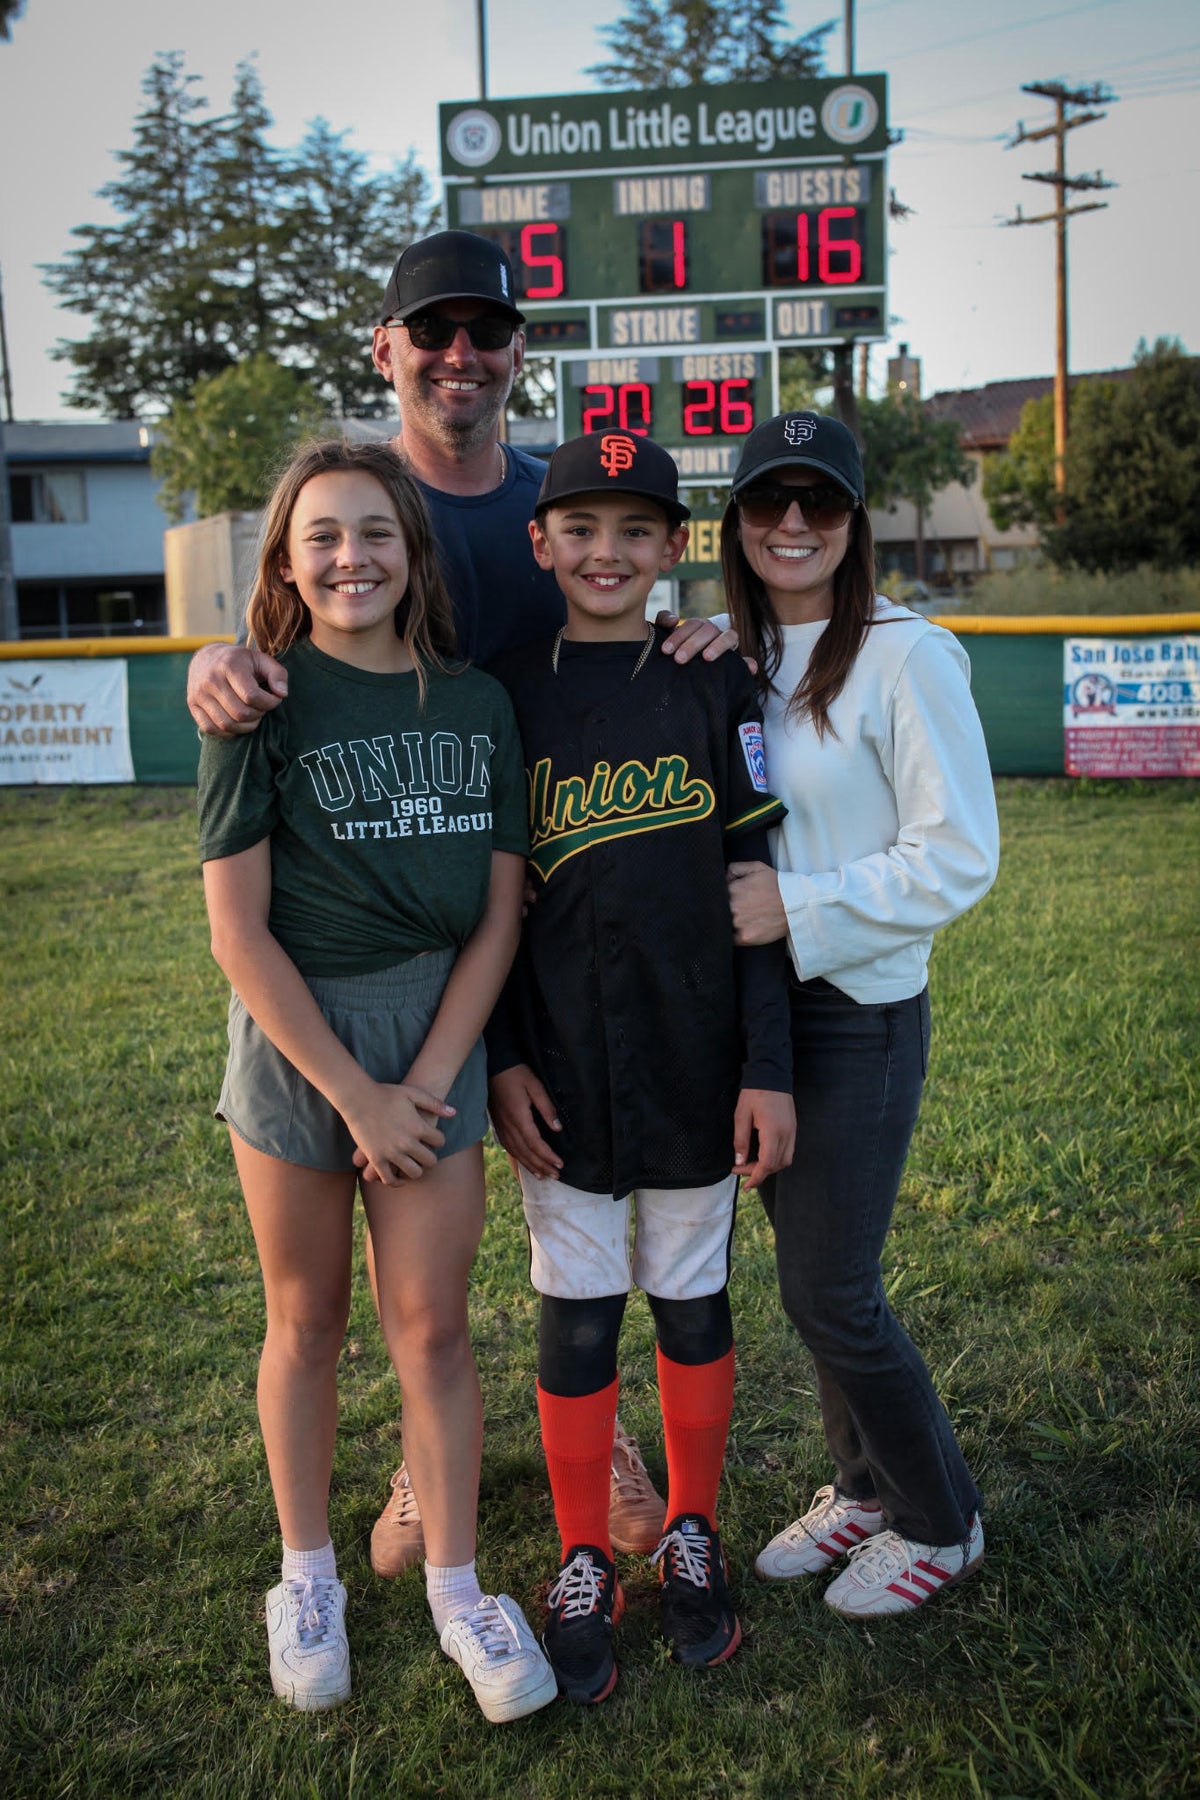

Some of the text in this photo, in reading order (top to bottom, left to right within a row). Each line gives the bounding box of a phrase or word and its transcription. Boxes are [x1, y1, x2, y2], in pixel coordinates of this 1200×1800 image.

[508, 98, 817, 157] Union Little League
[480, 184, 549, 223] HOME
[618, 176, 705, 213] INNING
[766, 167, 862, 204] GUESTS
[520, 222, 564, 298] 5
[672, 221, 686, 288] 1
[797, 206, 862, 284] 16
[612, 308, 699, 345] STRIKE
[777, 302, 825, 336] OUT
[586, 358, 640, 382] HOME
[682, 353, 756, 381] GUESTS
[684, 378, 753, 435] 26
[1072, 645, 1106, 663] San
[1113, 644, 1155, 664] Jose
[0, 703, 86, 722] OPERTY
[0, 726, 113, 746] AGEMENT
[390, 796, 442, 820] 1960
[330, 817, 414, 841] LITTLE
